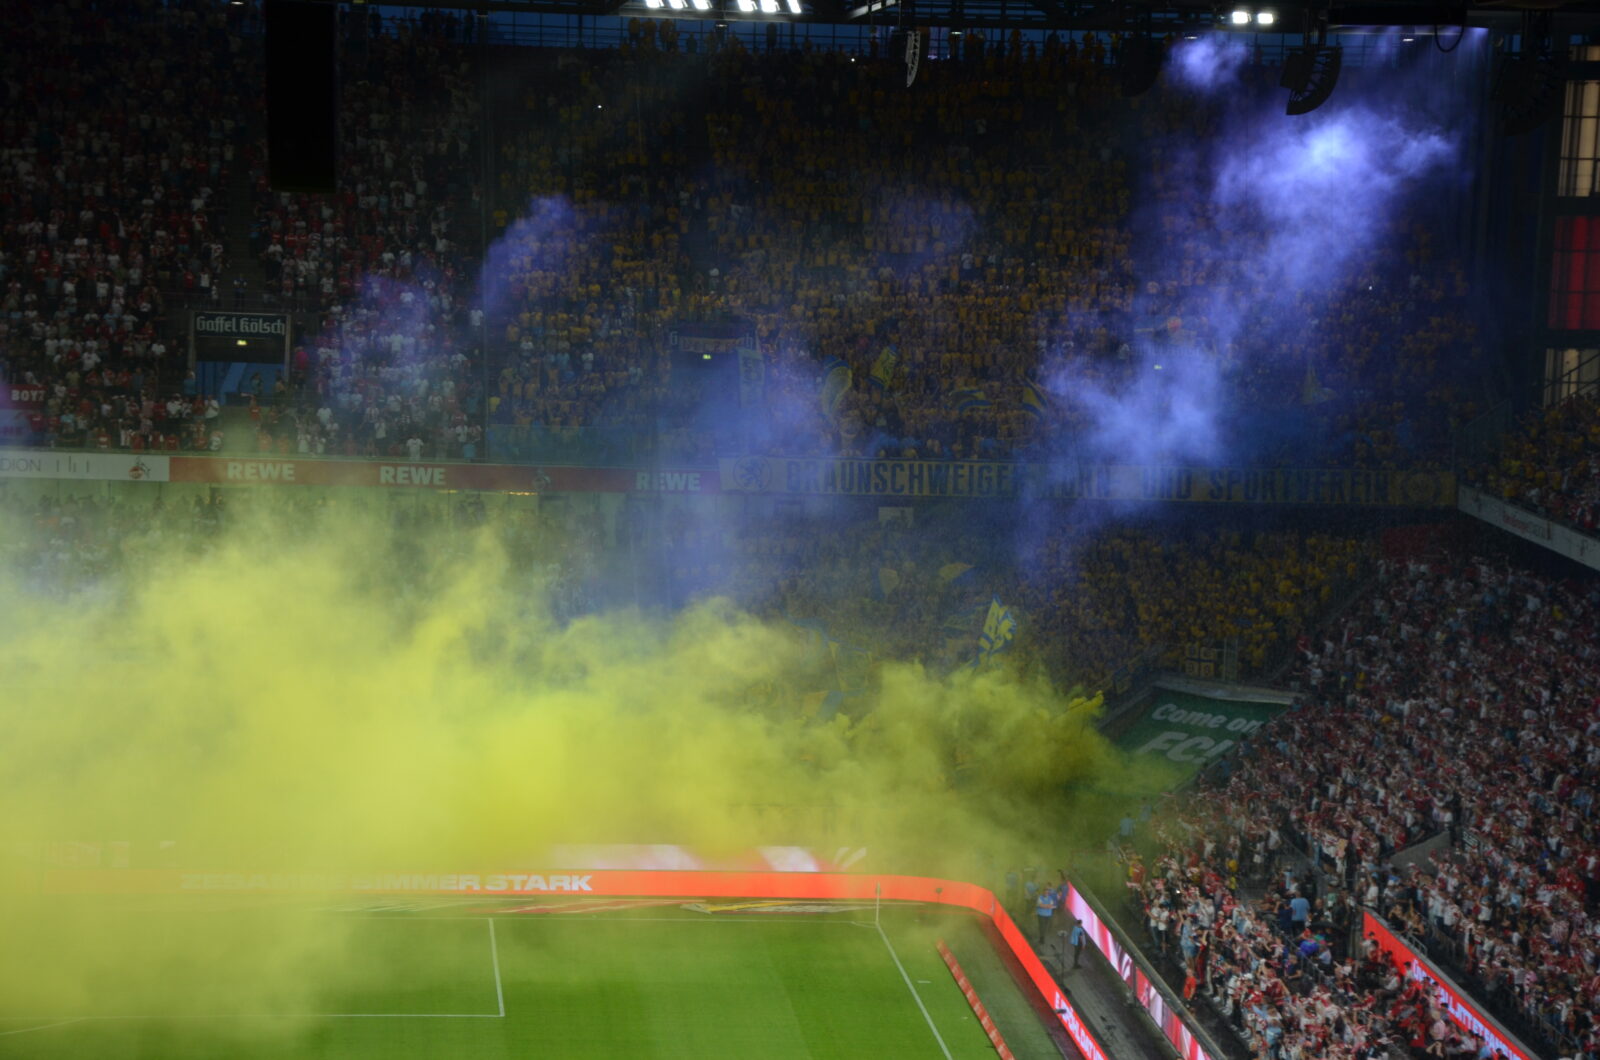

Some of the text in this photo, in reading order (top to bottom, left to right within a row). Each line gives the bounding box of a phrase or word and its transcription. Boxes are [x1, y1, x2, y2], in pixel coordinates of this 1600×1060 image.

[196, 316, 286, 336] Gaffel Kölsch
[227, 461, 295, 481] REWE
[379, 466, 446, 485] REWE
[635, 470, 701, 491] REWE
[1209, 468, 1390, 502] SPORTVEREIN
[1151, 703, 1264, 737] Come on
[1136, 731, 1235, 764] FC!
[485, 873, 592, 892] STARK
